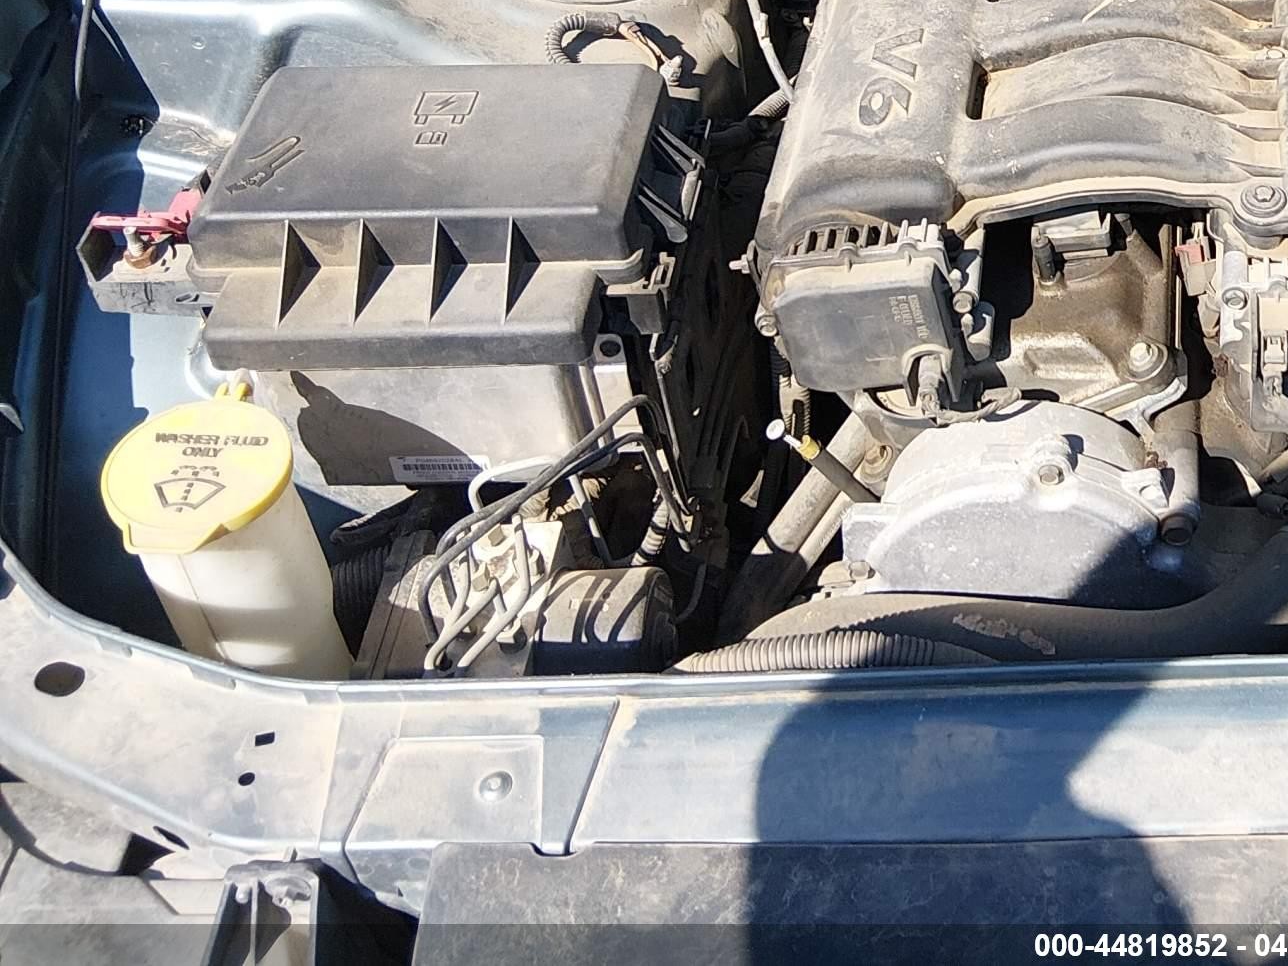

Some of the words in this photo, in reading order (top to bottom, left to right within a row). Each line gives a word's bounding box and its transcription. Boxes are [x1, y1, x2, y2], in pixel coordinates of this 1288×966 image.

[858, 27, 926, 127] V6
[155, 432, 219, 446] WASHER
[224, 435, 269, 447] FLUID
[182, 446, 224, 458] ONLY
